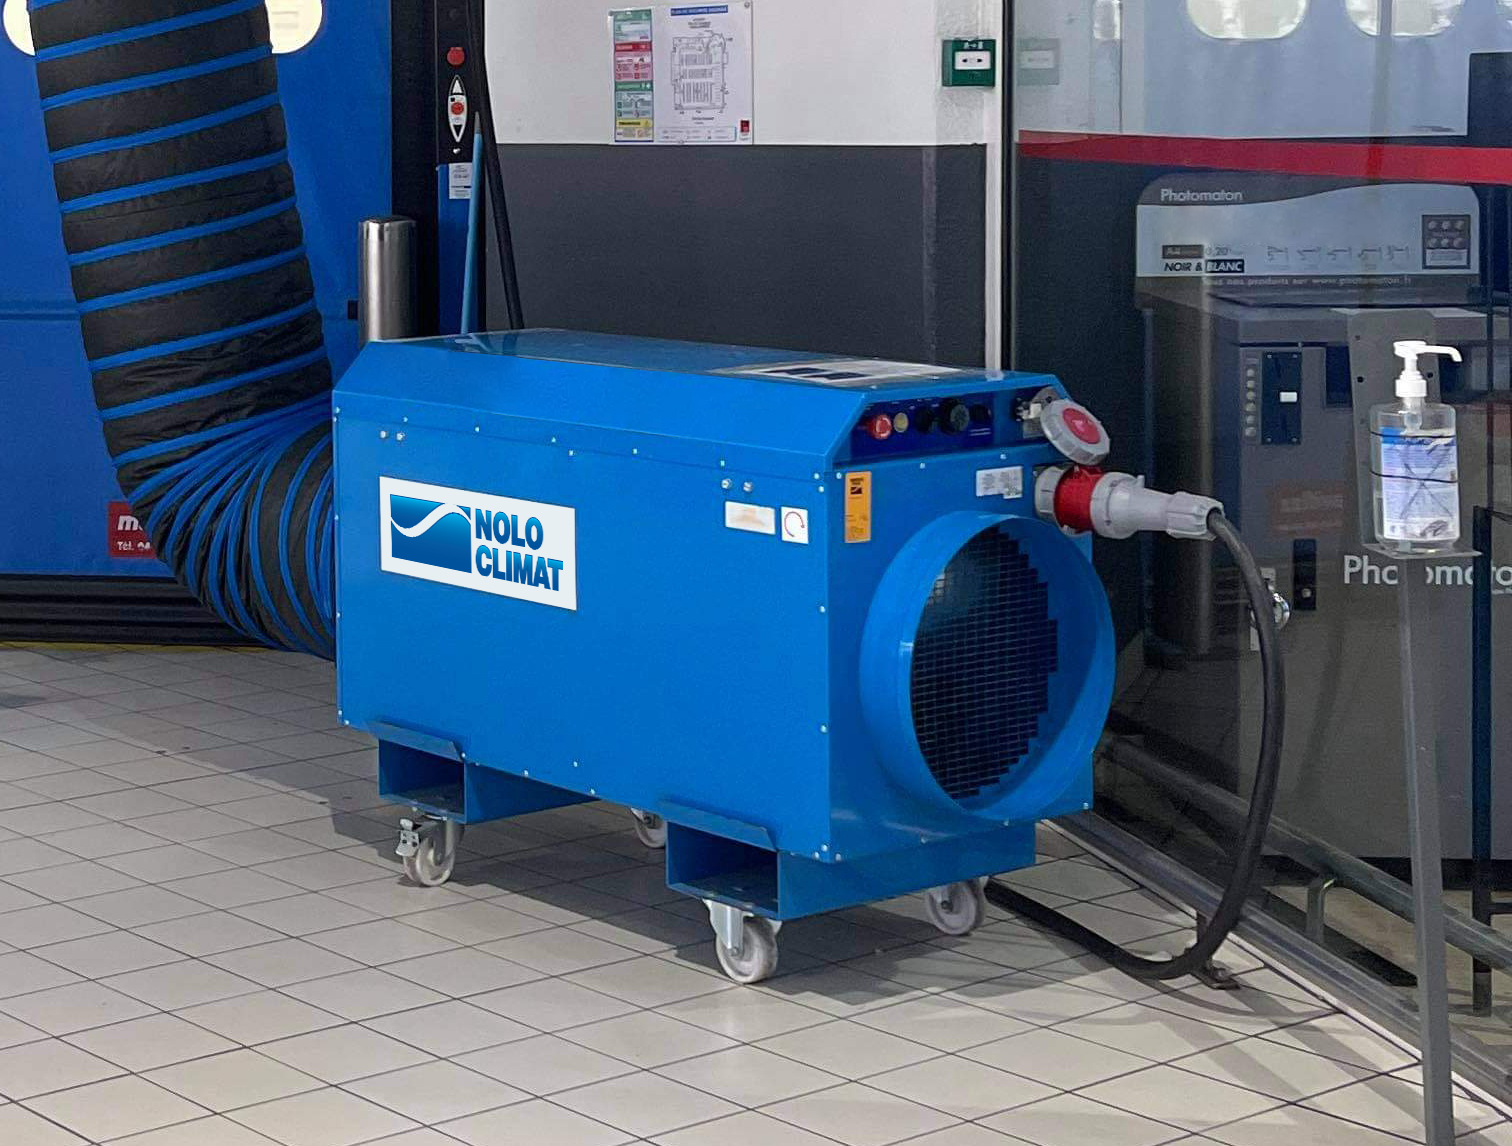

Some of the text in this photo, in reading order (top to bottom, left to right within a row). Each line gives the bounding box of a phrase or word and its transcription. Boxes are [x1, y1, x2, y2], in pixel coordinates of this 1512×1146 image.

[1160, 188, 1243, 202] Photomaton
[1163, 262, 1193, 272] NOIR
[1206, 261, 1243, 272] BLANC
[475, 508, 544, 550] NOLO
[475, 544, 564, 592] CLIMAT
